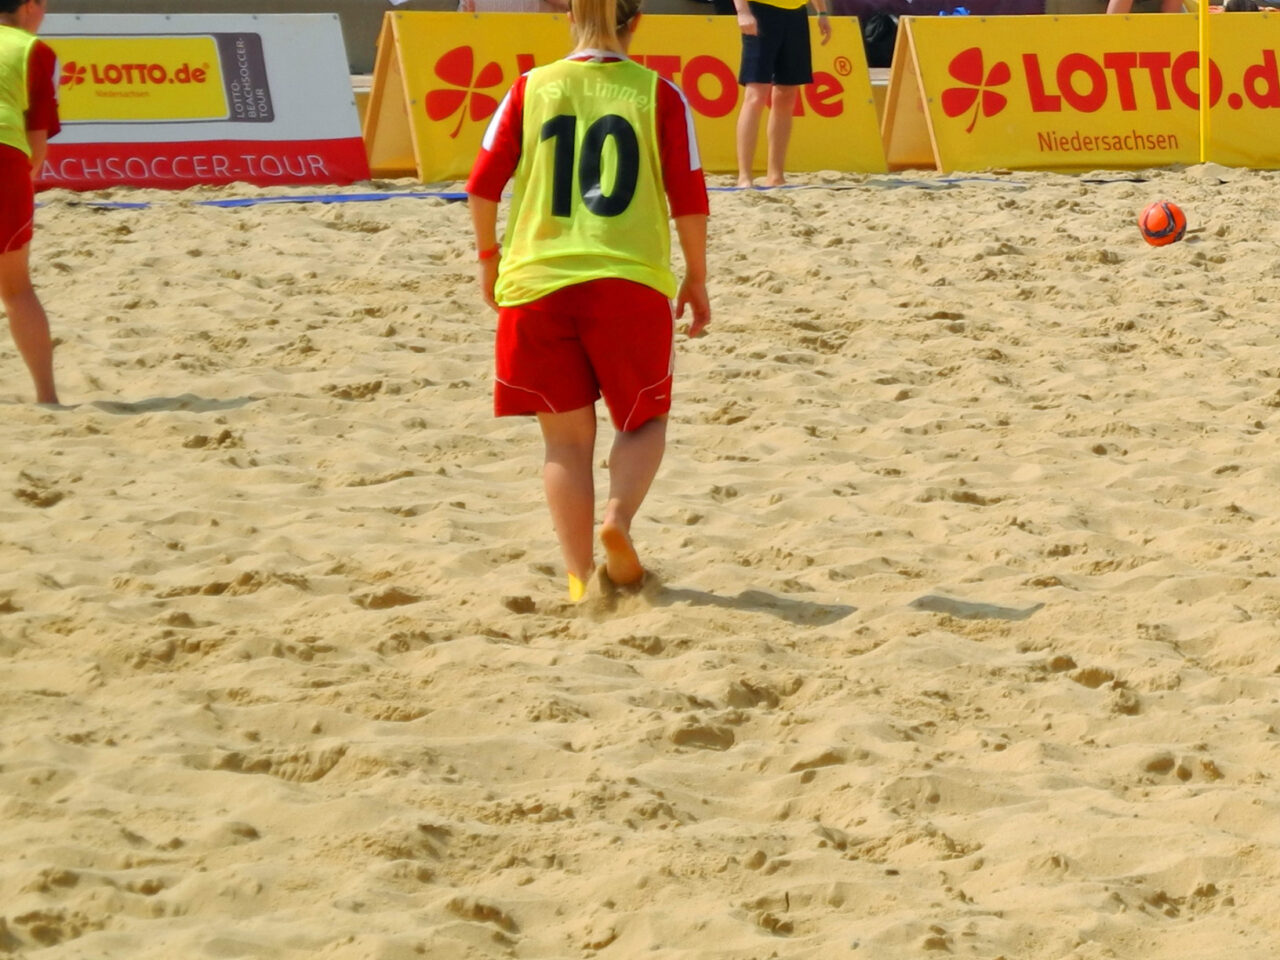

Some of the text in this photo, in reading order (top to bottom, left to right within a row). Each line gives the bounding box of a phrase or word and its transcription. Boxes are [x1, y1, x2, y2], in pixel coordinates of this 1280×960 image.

[236, 37, 257, 118] BEACHSOCCER-
[536, 77, 571, 104] TSV
[231, 79, 245, 118] LOTTO-
[255, 88, 269, 118] TOUR
[1038, 130, 1179, 152] Niedersachsen
[40, 155, 330, 181] ACHSOCCER-TOUR
[540, 114, 640, 218] 10
